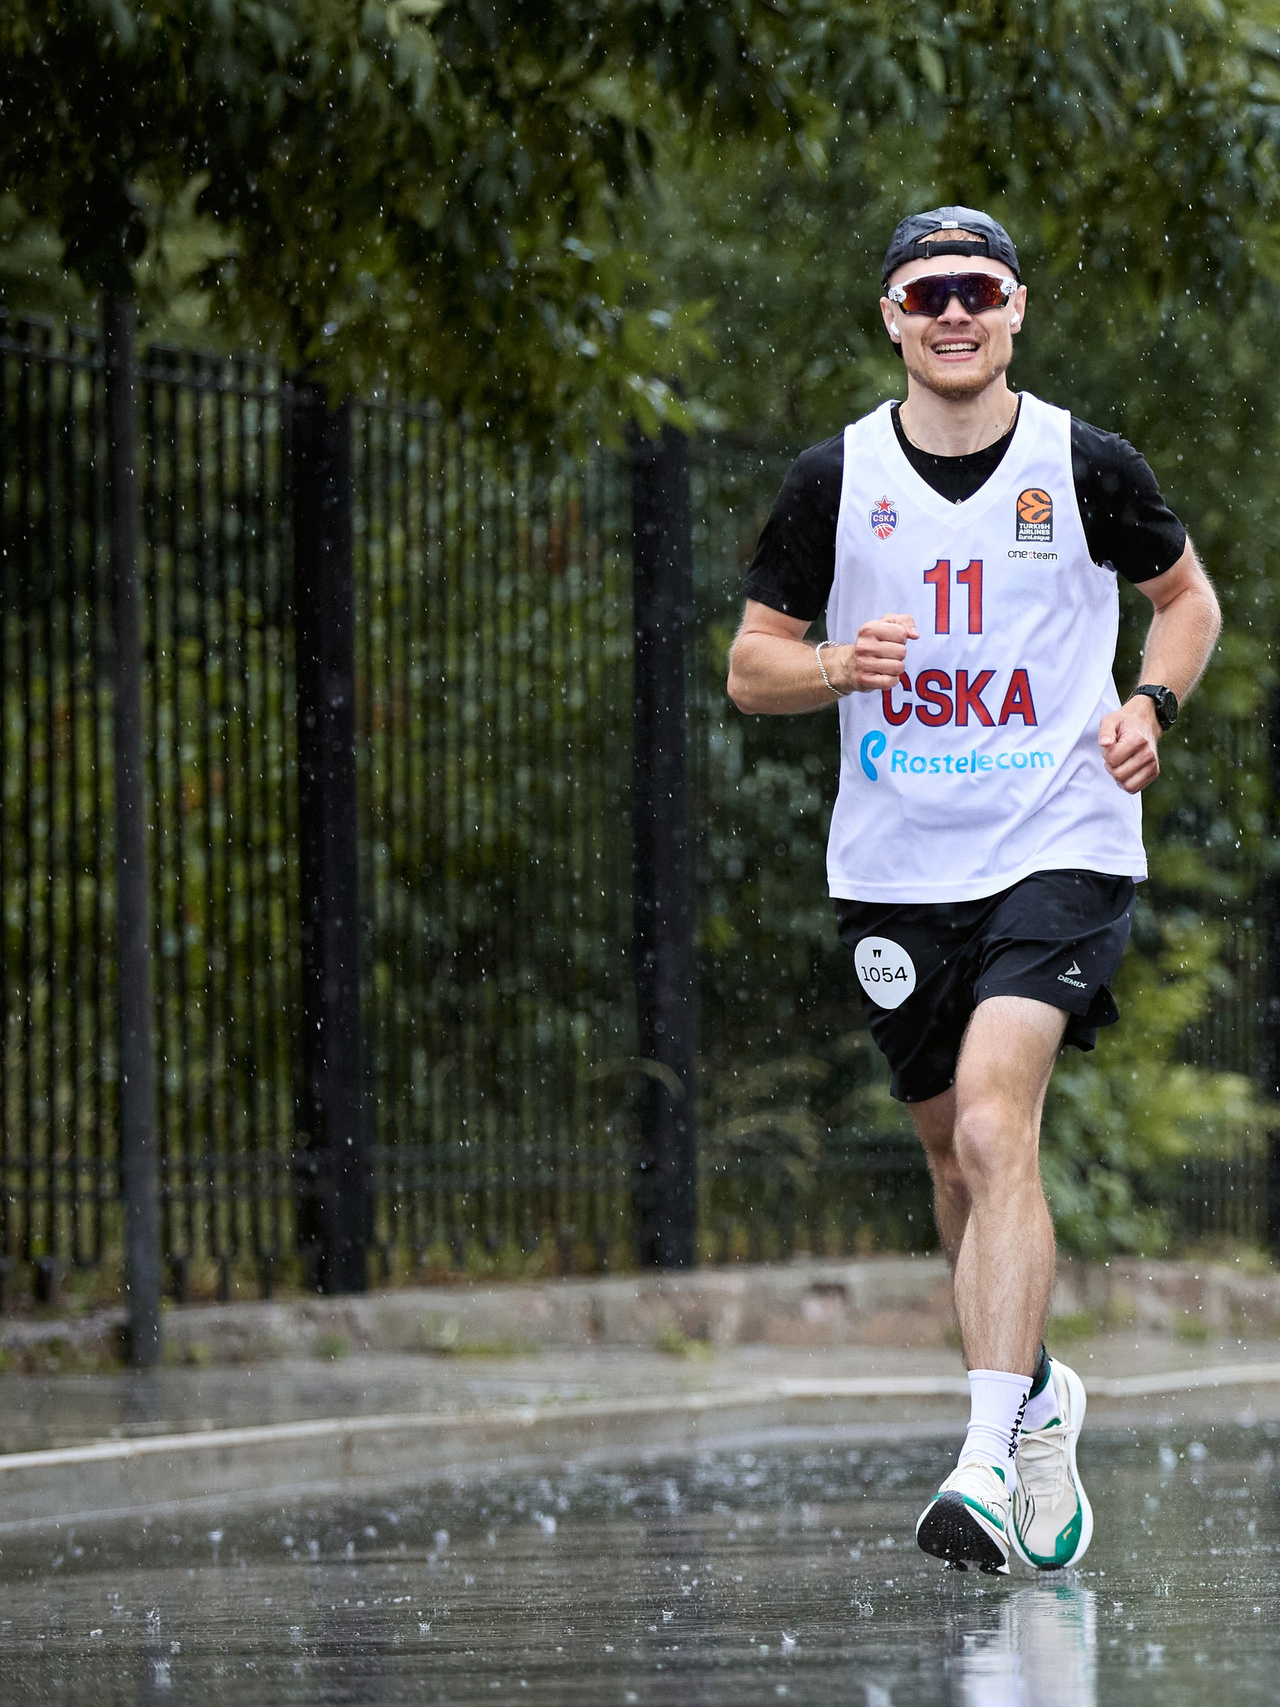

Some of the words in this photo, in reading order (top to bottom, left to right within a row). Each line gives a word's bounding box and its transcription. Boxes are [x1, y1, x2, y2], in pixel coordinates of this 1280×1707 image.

[872, 514, 895, 523] CSKA
[923, 559, 983, 635] 11
[882, 668, 1039, 728] CSKA
[891, 749, 1055, 774] Rostelecom
[861, 966, 908, 983] 1054
[1057, 974, 1088, 989] DEMIX
